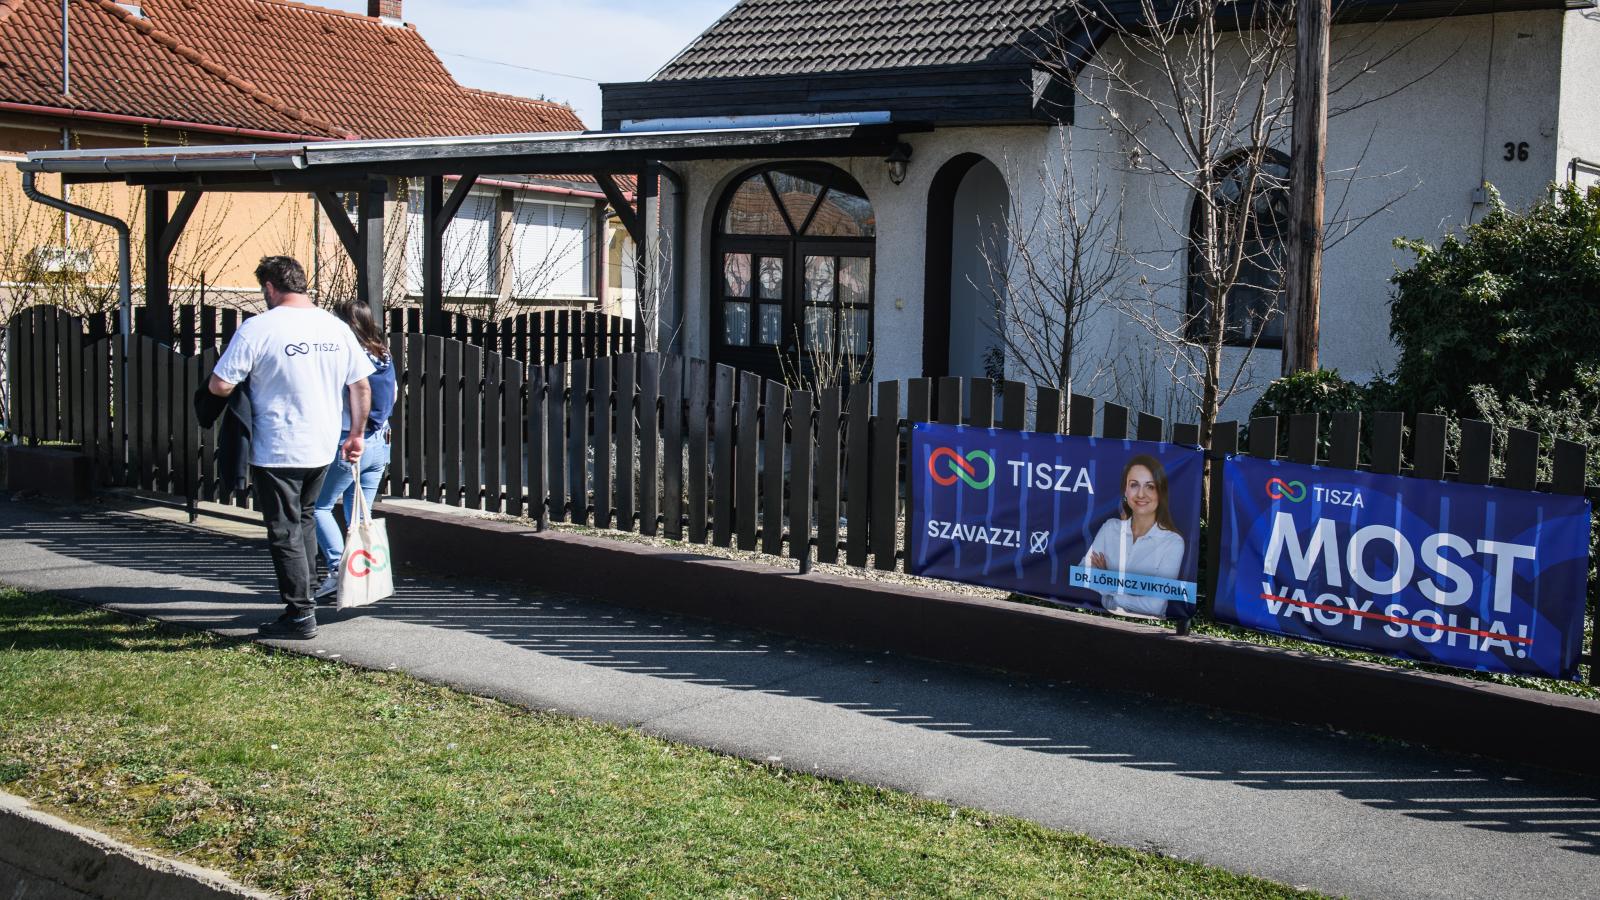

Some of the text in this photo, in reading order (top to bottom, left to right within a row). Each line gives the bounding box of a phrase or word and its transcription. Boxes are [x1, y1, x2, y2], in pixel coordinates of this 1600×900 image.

[1503, 141, 1530, 162] 36
[312, 343, 341, 352] TISZA
[1007, 459, 1095, 495] TISZA
[1313, 486, 1365, 509] TISZA
[928, 519, 1021, 548] SZAVAZZ!
[1263, 511, 1537, 614] MOST
[1074, 572, 1092, 583] DR.
[1140, 581, 1189, 597] VIKTÓRIA
[1261, 581, 1374, 632] VAGY
[1383, 603, 1529, 660] SOHA!
